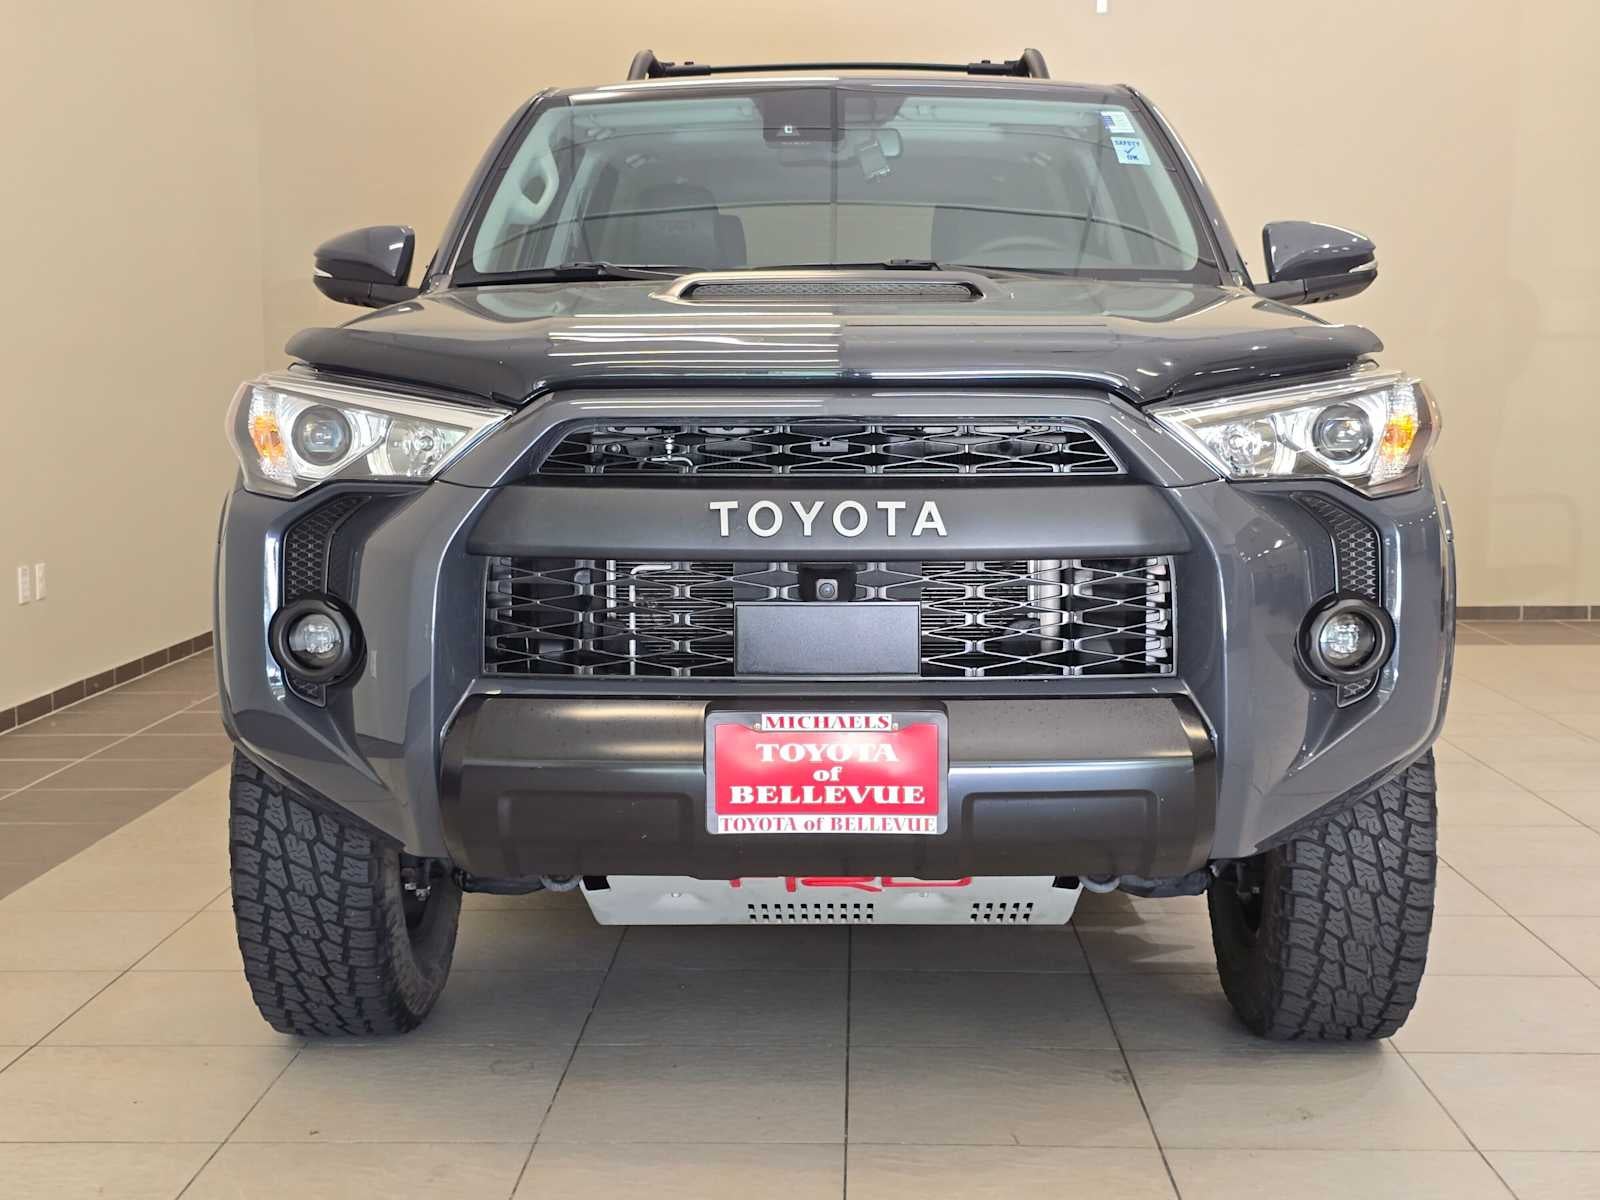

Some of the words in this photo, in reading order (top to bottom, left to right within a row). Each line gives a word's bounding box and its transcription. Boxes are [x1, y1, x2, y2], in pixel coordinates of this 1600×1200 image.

[709, 500, 947, 537] TOYOTA
[765, 715, 890, 730] MICHAELS
[756, 743, 899, 763] TOYOTA
[812, 766, 842, 782] of
[729, 785, 926, 805] BELLEVUE
[719, 817, 797, 832] TOYOTA
[804, 817, 824, 832] of
[830, 817, 936, 833] BELLEVUE
